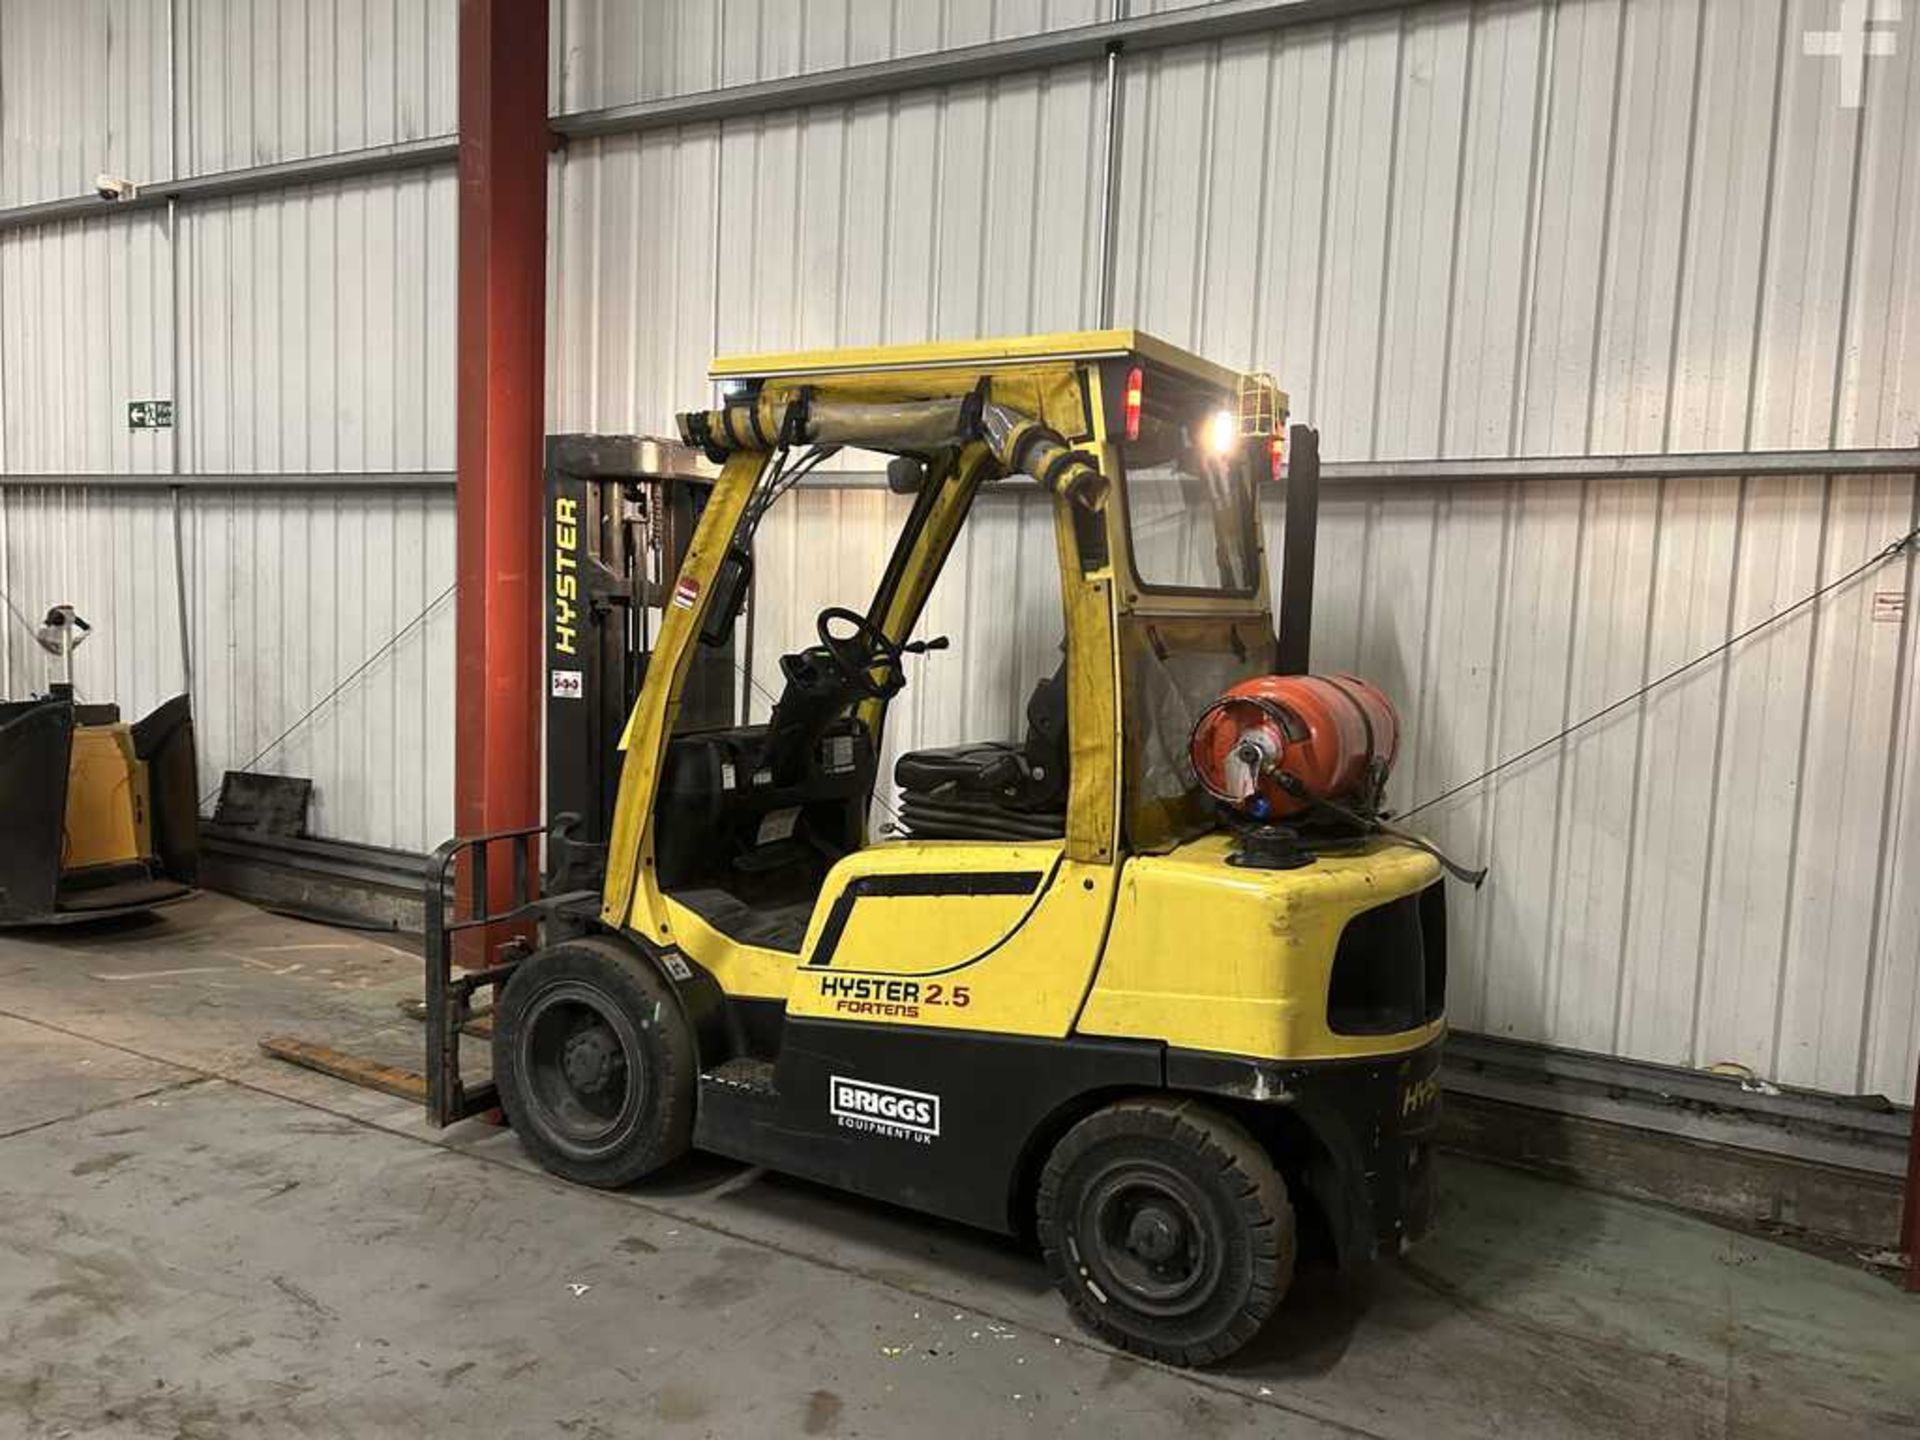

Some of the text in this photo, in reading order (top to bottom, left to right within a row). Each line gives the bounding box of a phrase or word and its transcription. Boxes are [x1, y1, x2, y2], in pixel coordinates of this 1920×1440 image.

[555, 498, 576, 654] HYSTER
[822, 978, 970, 1007] HYSTER 2.5
[838, 1087, 931, 1123] BRIGGS
[838, 1117, 932, 1145] EQUIPMENT UK
